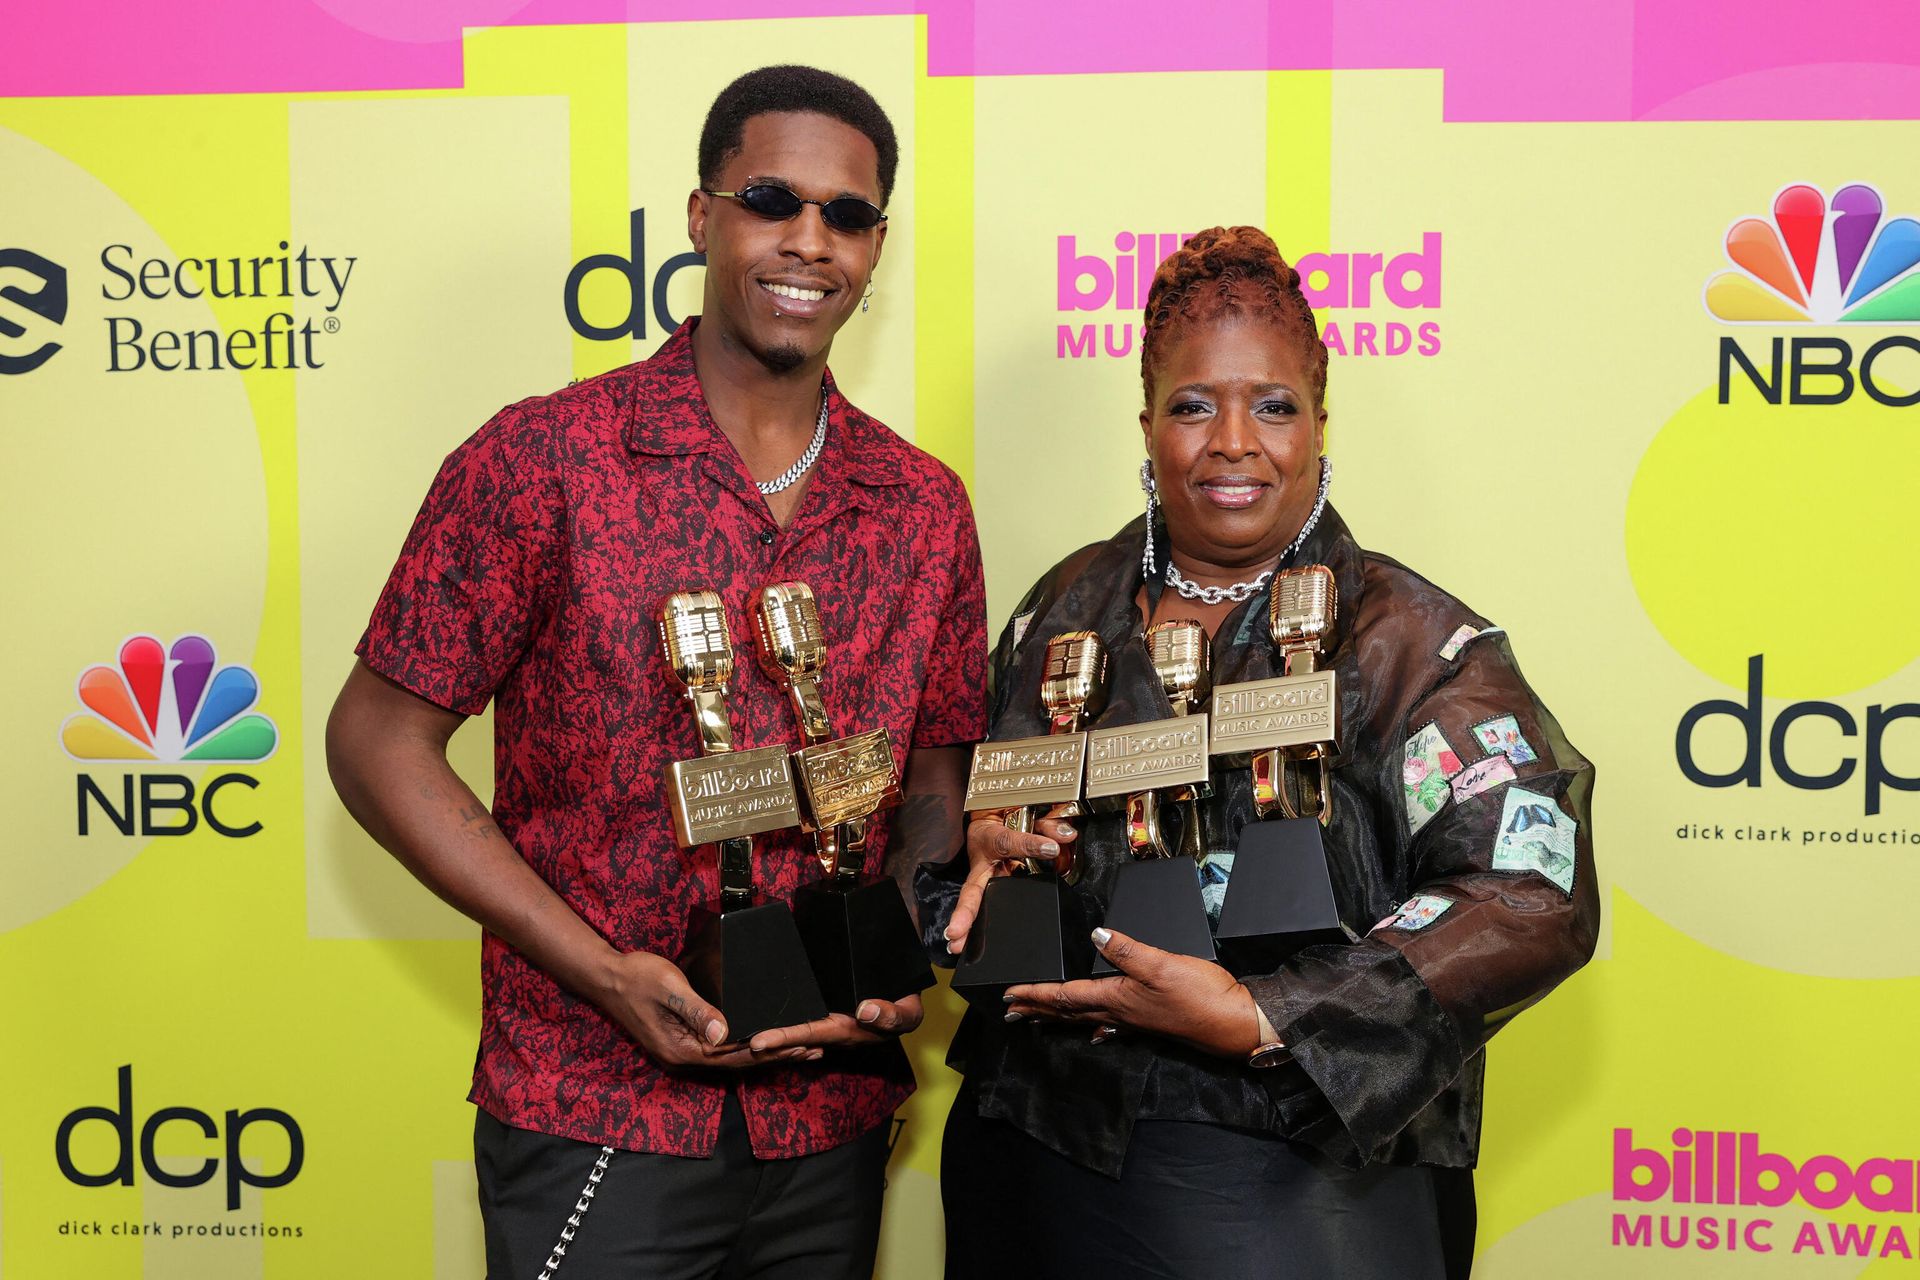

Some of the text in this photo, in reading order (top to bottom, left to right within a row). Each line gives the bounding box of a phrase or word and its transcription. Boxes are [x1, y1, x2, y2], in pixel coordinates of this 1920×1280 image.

[101, 240, 358, 312] Security
[1057, 231, 1442, 311] bilard
[1321, 321, 1441, 357] ARDS
[1718, 335, 1920, 407] NBC
[1215, 682, 1328, 717] billboard
[1091, 725, 1201, 761] billboard
[1214, 711, 1328, 736] MUSIC AWARDS
[1675, 653, 1920, 816] dcp
[682, 759, 790, 801] billboard
[1090, 753, 1201, 779] MUSIC AWARDS
[76, 773, 264, 838] NBC
[689, 793, 793, 824] MUSIC AWARDS
[1676, 824, 1724, 840] dick
[1734, 825, 1791, 842] clark
[55, 1063, 305, 1212] dcp
[1612, 1126, 1920, 1213] billboa
[58, 1221, 304, 1239] dick clark productions
[1611, 1213, 1920, 1260] MUSIC AWA
